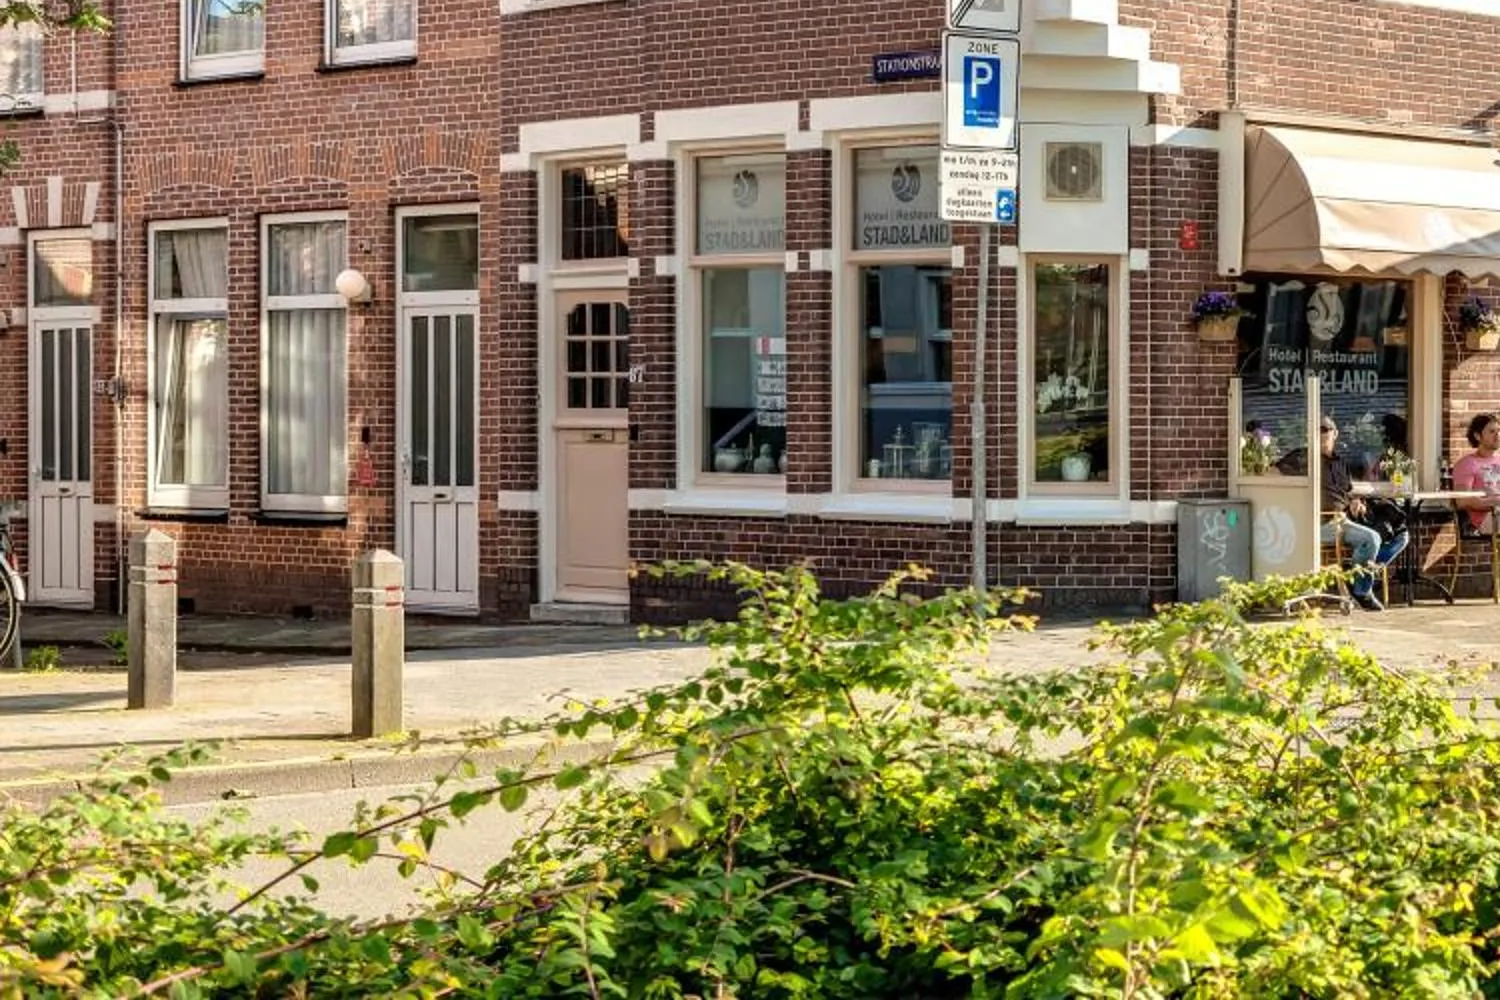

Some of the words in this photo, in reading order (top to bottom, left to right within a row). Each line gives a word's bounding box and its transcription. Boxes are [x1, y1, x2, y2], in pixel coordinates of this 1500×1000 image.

[967, 41, 999, 55] ZONE
[971, 60, 993, 99] P
[863, 223, 949, 247] STAD&LAND
[1268, 346, 1302, 362] Hotel
[1312, 348, 1378, 366] Restaurant
